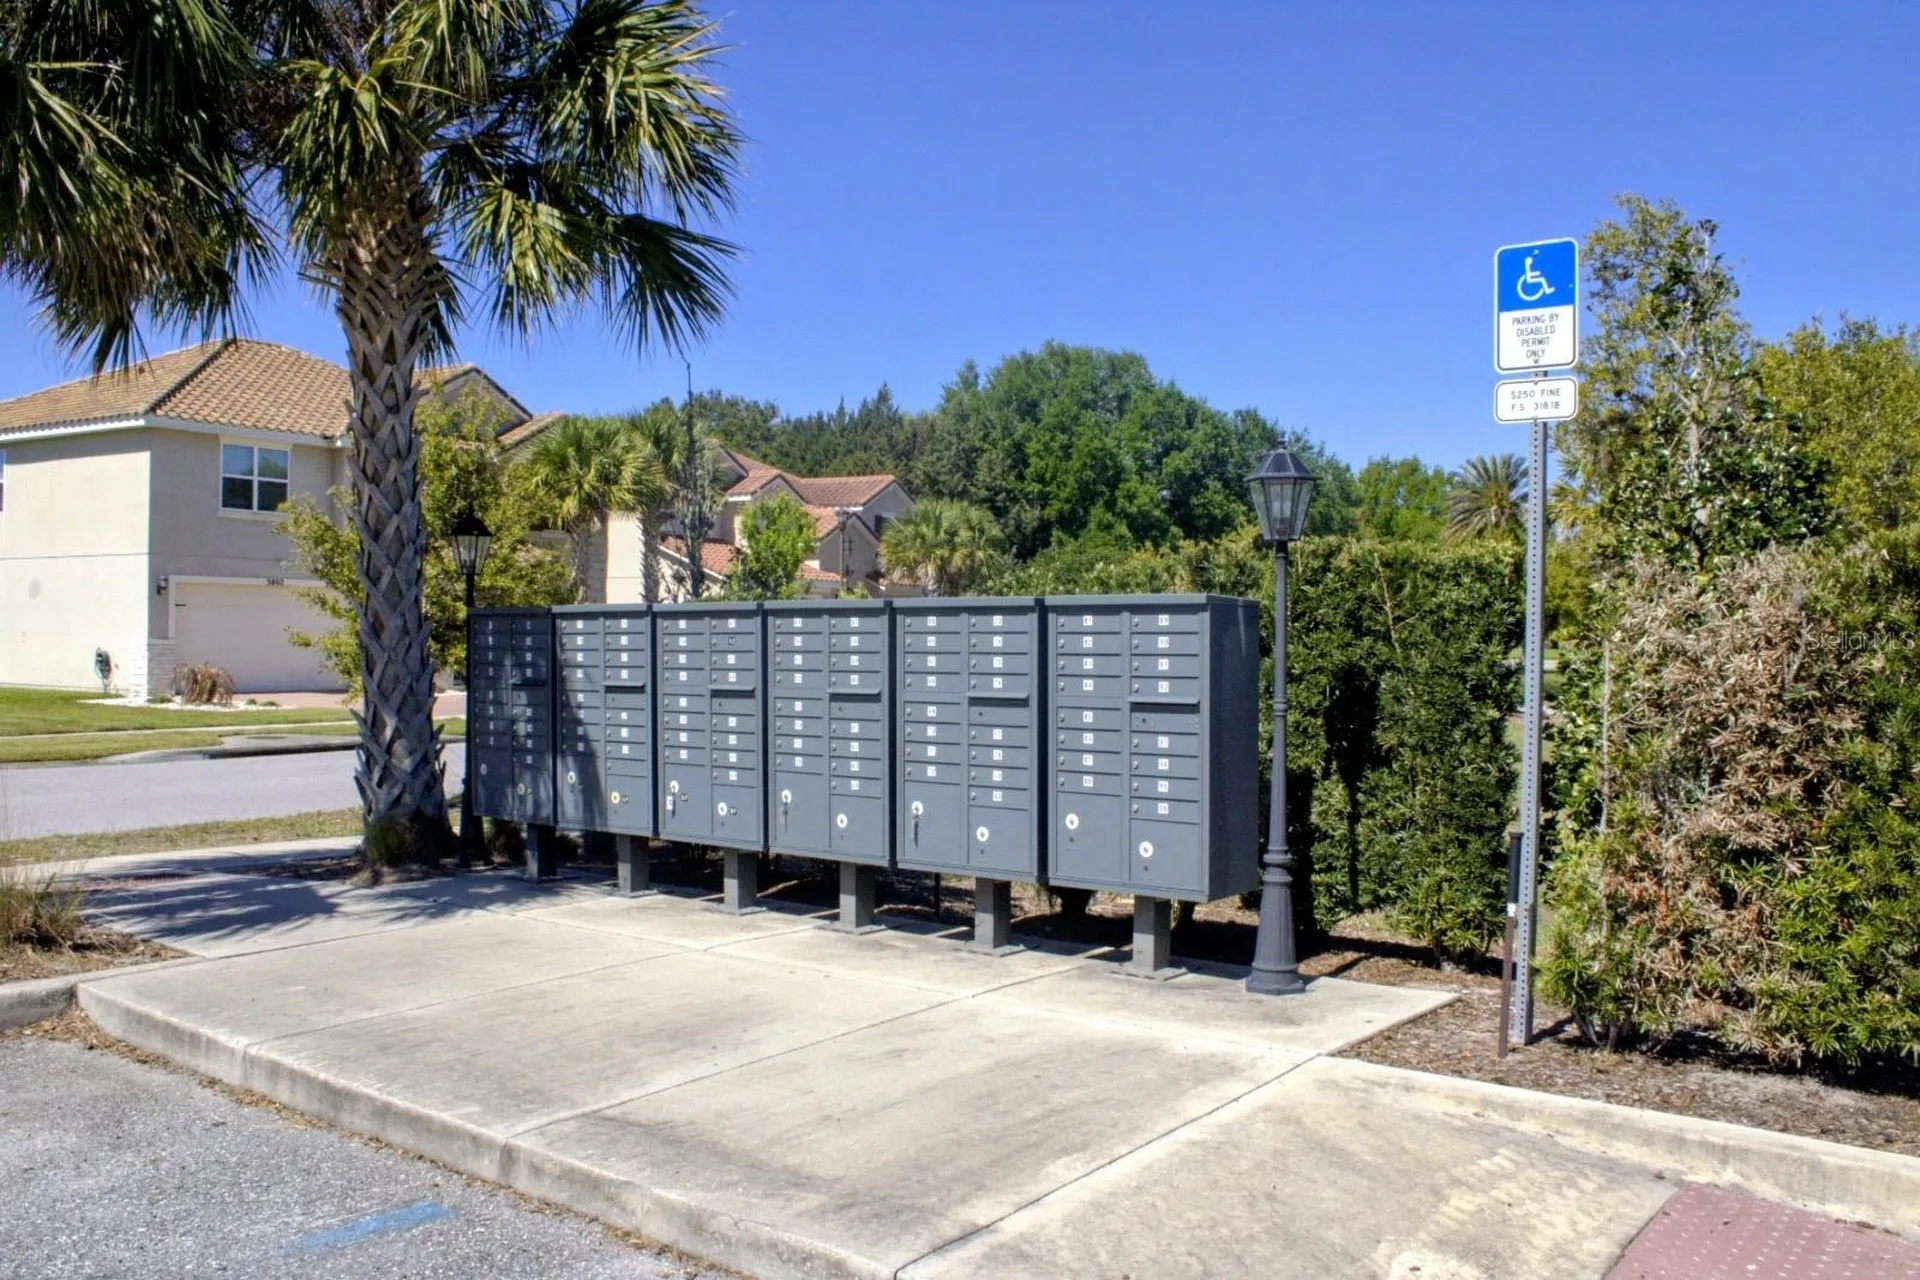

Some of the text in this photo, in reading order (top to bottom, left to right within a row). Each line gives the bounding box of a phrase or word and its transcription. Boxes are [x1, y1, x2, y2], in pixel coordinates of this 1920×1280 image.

[1512, 313, 1560, 326] PARKING BY
[1516, 325, 1556, 337] DISABLED
[1521, 336, 1550, 348] PERMIT
[1526, 348, 1546, 359] ONLY
[1511, 388, 1562, 400] $250 FINE
